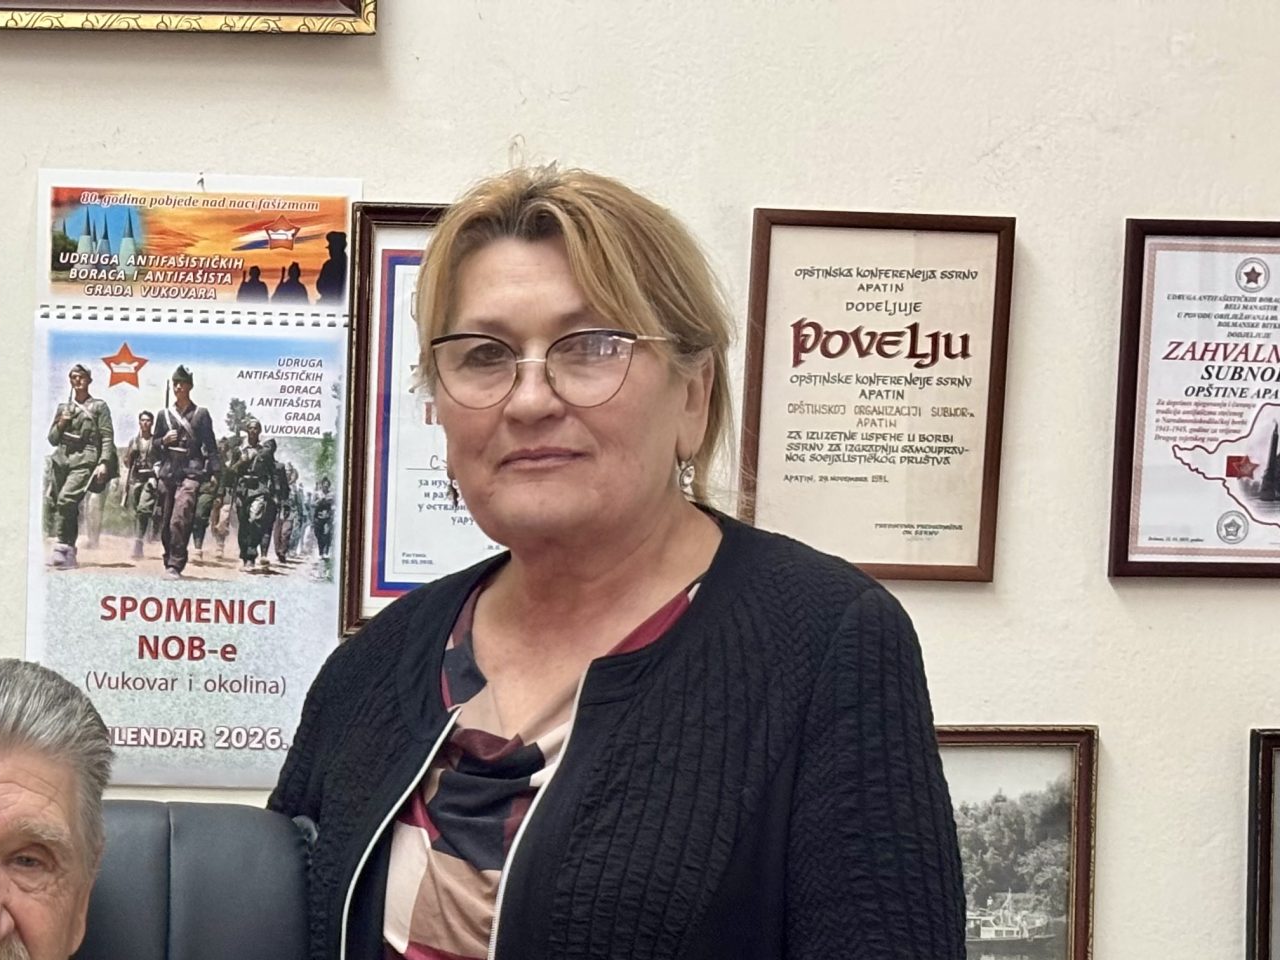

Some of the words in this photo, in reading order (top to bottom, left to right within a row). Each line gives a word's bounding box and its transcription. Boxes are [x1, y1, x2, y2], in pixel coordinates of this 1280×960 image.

[80, 192, 100, 205] 80.
[102, 194, 146, 208] godina
[148, 195, 198, 210] pobjede
[201, 196, 225, 208] nad
[58, 252, 119, 266] UDRUGA
[126, 253, 244, 268] ANTIFAŠISTIČKIH
[69, 268, 125, 281] BORACA
[132, 270, 138, 281] I
[144, 268, 232, 285] ANTIFAŠISTA
[84, 284, 132, 297] GRADA
[140, 285, 216, 300] VUKOVARA
[857, 283, 904, 292] APATIN
[845, 300, 922, 316] DODELJUJE
[277, 358, 323, 368] UDRUGA
[237, 369, 323, 382] ANTIFAŠISTIČKIH
[279, 385, 322, 395] BORACA
[858, 389, 904, 400] APATIN
[1184, 384, 1249, 398] OPŠTINE
[257, 397, 322, 409] ANTIFAŠISTA
[787, 402, 846, 415] OPŠTINSKOJ
[854, 406, 922, 417] ORGANIZACIJI
[284, 412, 321, 422] GRADA
[856, 418, 897, 428] APATIN
[264, 425, 321, 435] VUKOVARA
[786, 430, 802, 439] ZA
[806, 430, 858, 442] IZUZETNE
[861, 432, 904, 442] USPEHE
[908, 434, 916, 442] U
[919, 434, 953, 443] BORBI
[827, 443, 842, 452] ZA
[845, 444, 898, 454] IZGRADNJU
[785, 453, 806, 462] NOG
[899, 455, 951, 466] DRUŠTVA
[100, 596, 276, 625] SPOMENICI
[138, 635, 238, 662] NOB-e
[85, 671, 178, 692] (Vukovar
[188, 673, 192, 691] i
[204, 675, 286, 697] okolina)
[106, 726, 205, 748] LENDAR
[214, 726, 289, 750] 2026.
